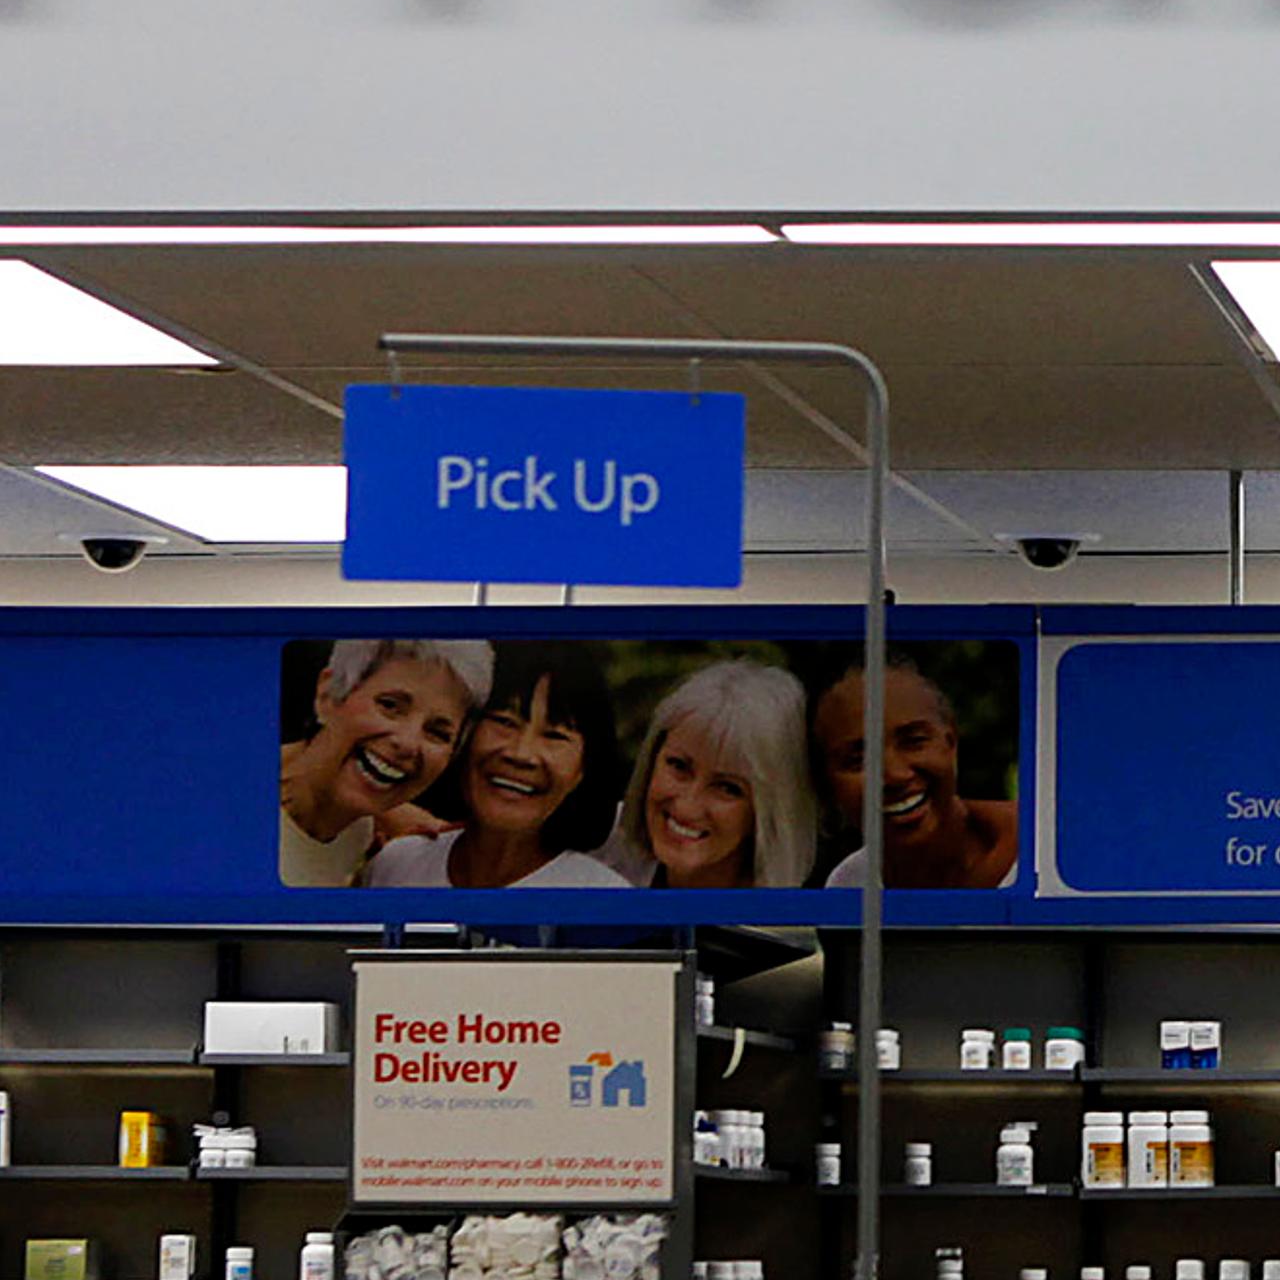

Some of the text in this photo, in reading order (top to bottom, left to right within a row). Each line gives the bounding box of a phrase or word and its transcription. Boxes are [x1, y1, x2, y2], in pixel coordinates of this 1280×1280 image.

[437, 455, 660, 526] Pick Up
[1226, 837, 1267, 865] for
[373, 1014, 561, 1044] Free Home
[373, 1052, 518, 1091] Delivery
